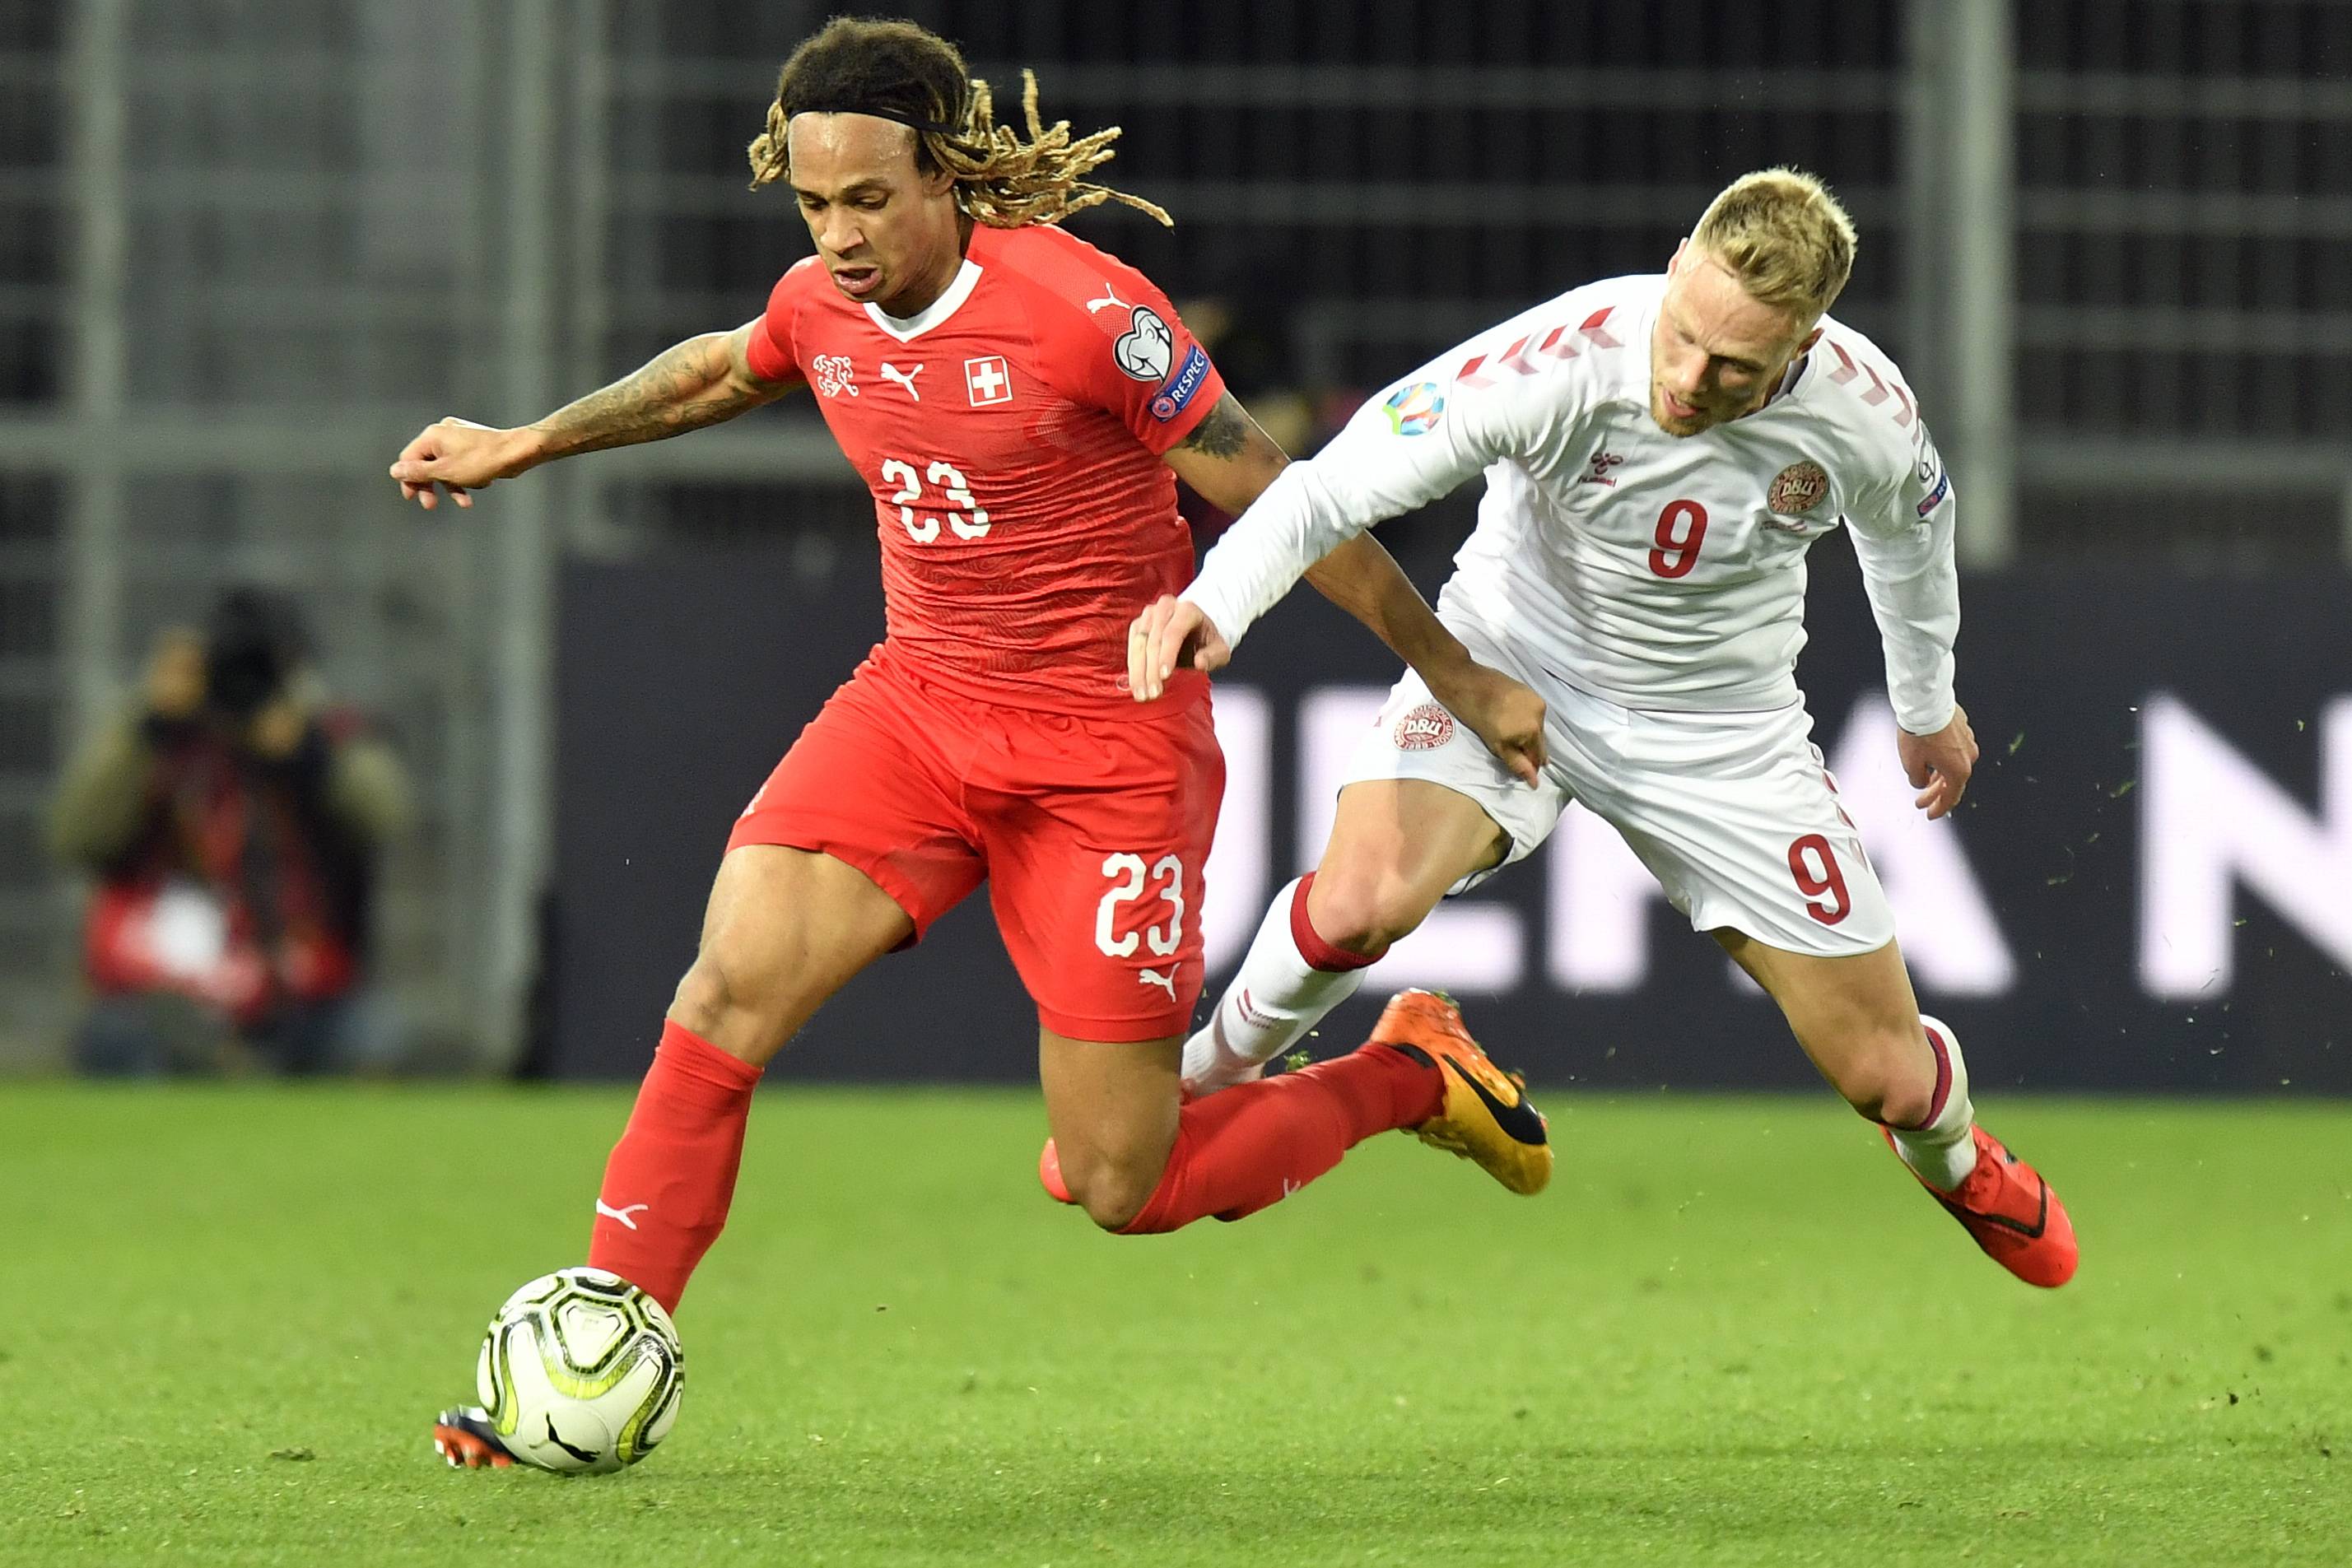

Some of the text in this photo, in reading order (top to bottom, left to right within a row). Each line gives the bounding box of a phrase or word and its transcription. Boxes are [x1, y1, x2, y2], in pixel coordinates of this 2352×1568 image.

[1171, 348, 1205, 403] RESPECT
[881, 458, 991, 543] 23
[1781, 478, 1817, 498] DBU
[1648, 499, 1707, 579] 9
[1404, 719, 1443, 736] DBU
[1095, 852, 1184, 957] 23
[1787, 833, 1851, 925] 9
